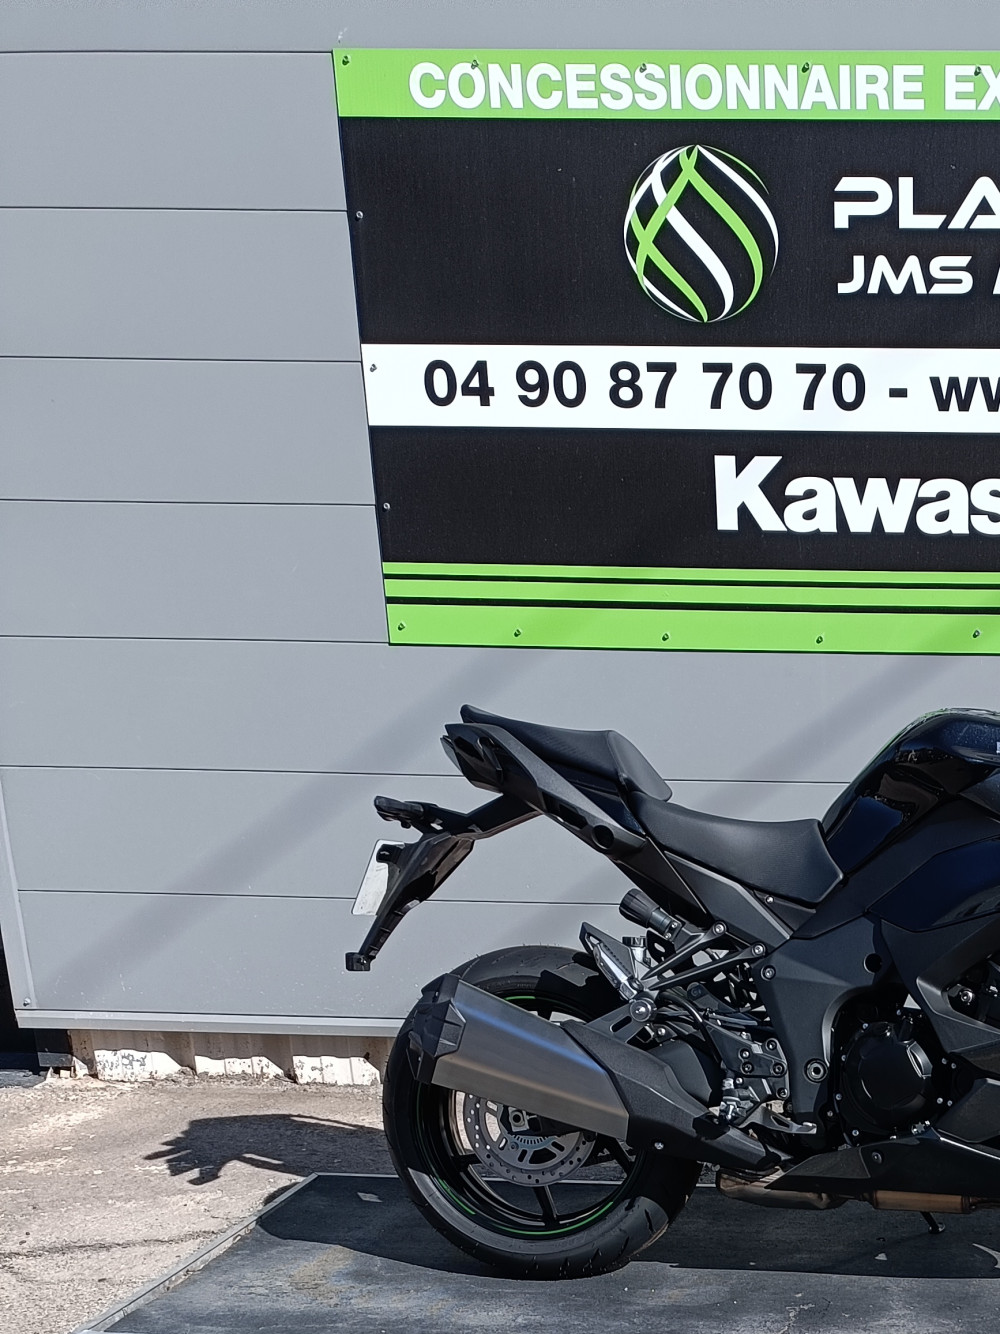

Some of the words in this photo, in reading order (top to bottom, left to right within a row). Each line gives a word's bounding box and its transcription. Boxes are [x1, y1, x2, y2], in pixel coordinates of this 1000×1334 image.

[409, 62, 925, 111] CONCESSIONNAIRE
[837, 254, 974, 295] JMS
[424, 359, 495, 407] 04
[515, 360, 587, 409] 90
[609, 360, 677, 410] 87
[702, 362, 773, 411] 70
[795, 363, 866, 412] 70
[888, 387, 908, 398] -
